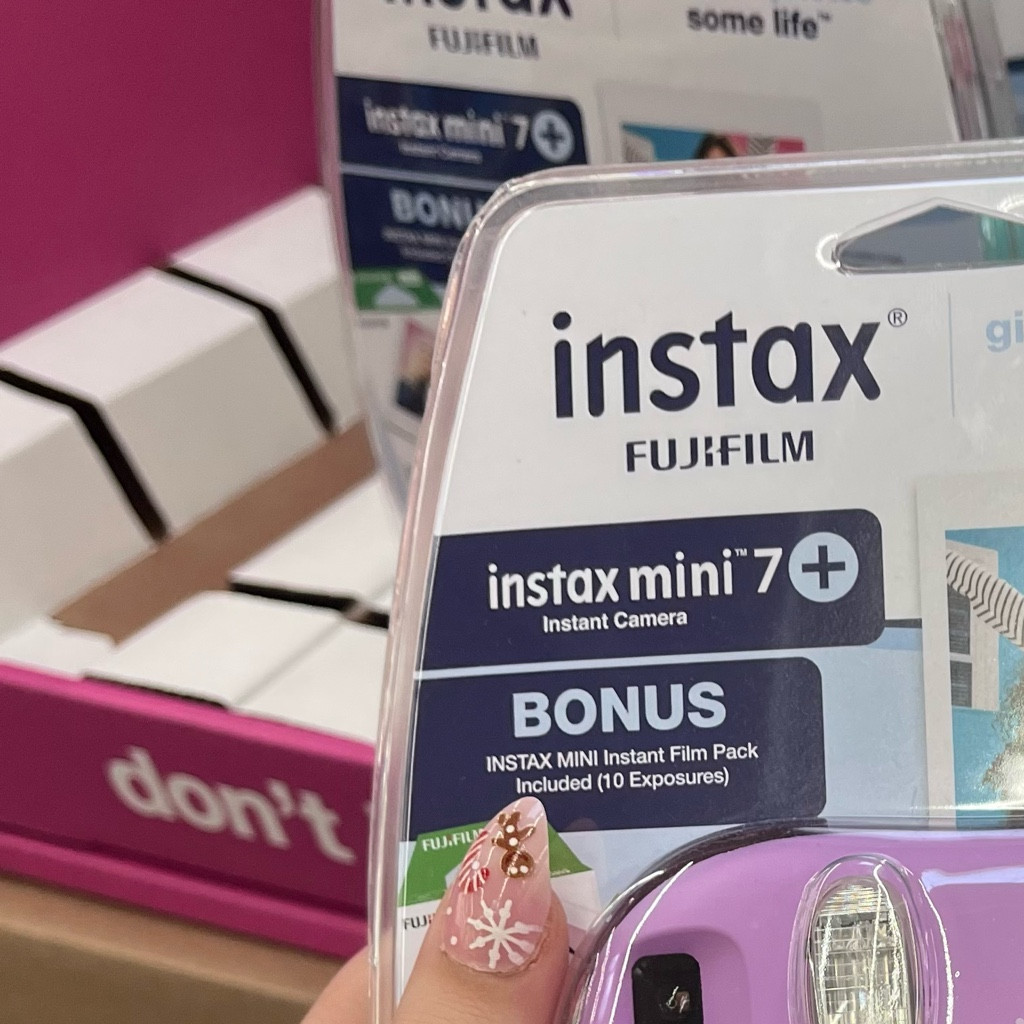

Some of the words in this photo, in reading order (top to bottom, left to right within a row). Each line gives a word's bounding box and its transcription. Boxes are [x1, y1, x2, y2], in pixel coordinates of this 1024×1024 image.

[686, 8, 765, 36] some
[427, 24, 540, 60] FUJIFILM
[389, 187, 484, 232] BON
[626, 430, 814, 472] FUJIFILM
[488, 563, 619, 610] instax
[543, 613, 609, 633] Instant
[613, 611, 688, 630] Camera
[512, 681, 727, 739] BONUS
[486, 752, 553, 773] INSTAX
[557, 749, 598, 768] MINI
[604, 747, 665, 766] Instant
[670, 744, 708, 762] Film
[713, 742, 759, 760] Pack
[516, 773, 592, 794] Included
[597, 772, 625, 793] (10
[629, 767, 730, 791] Exposures)
[107, 745, 355, 865] don't
